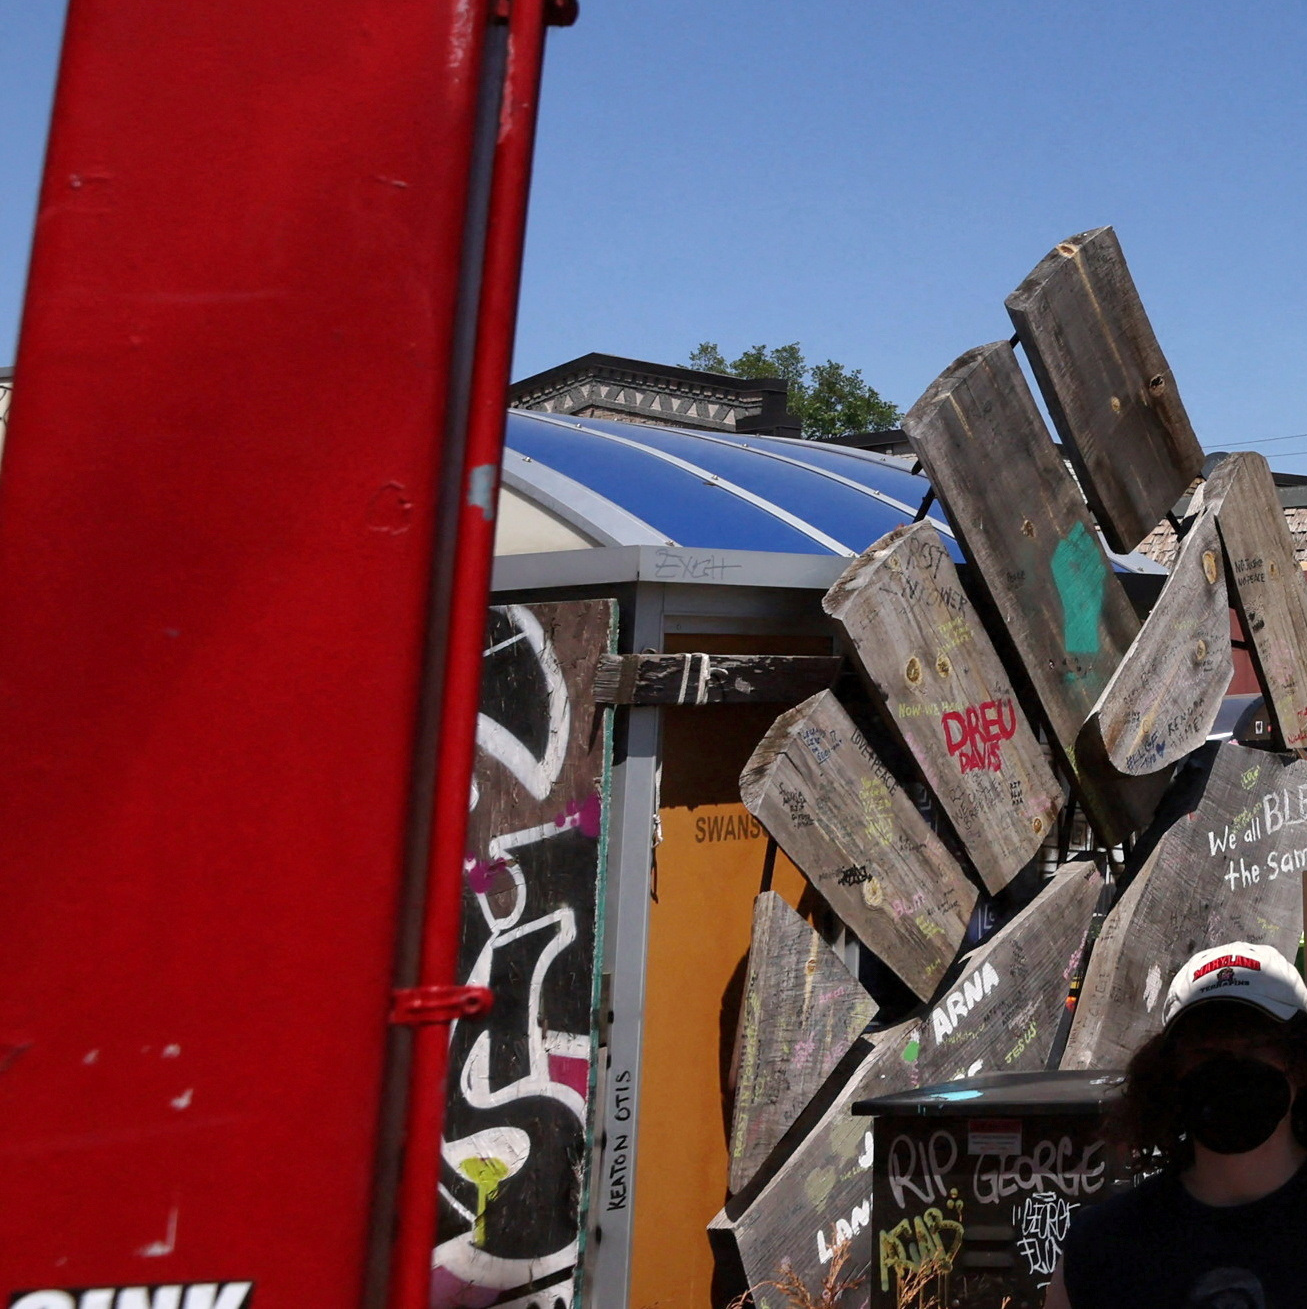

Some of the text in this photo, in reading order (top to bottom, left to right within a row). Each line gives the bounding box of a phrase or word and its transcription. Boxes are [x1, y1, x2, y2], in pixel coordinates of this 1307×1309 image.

[959, 743, 1002, 775] DAVIS
[695, 814, 769, 844] SWANS
[1208, 817, 1261, 857] We all
[1225, 859, 1260, 891] the
[1192, 954, 1262, 983] MARYLAND
[932, 962, 1000, 1046] ARNA
[1004, 1021, 1037, 1064] JESUS
[606, 1069, 632, 1212] KEATON OTIS
[887, 1130, 959, 1210] RIP
[973, 1136, 1107, 1205] GEORGE
